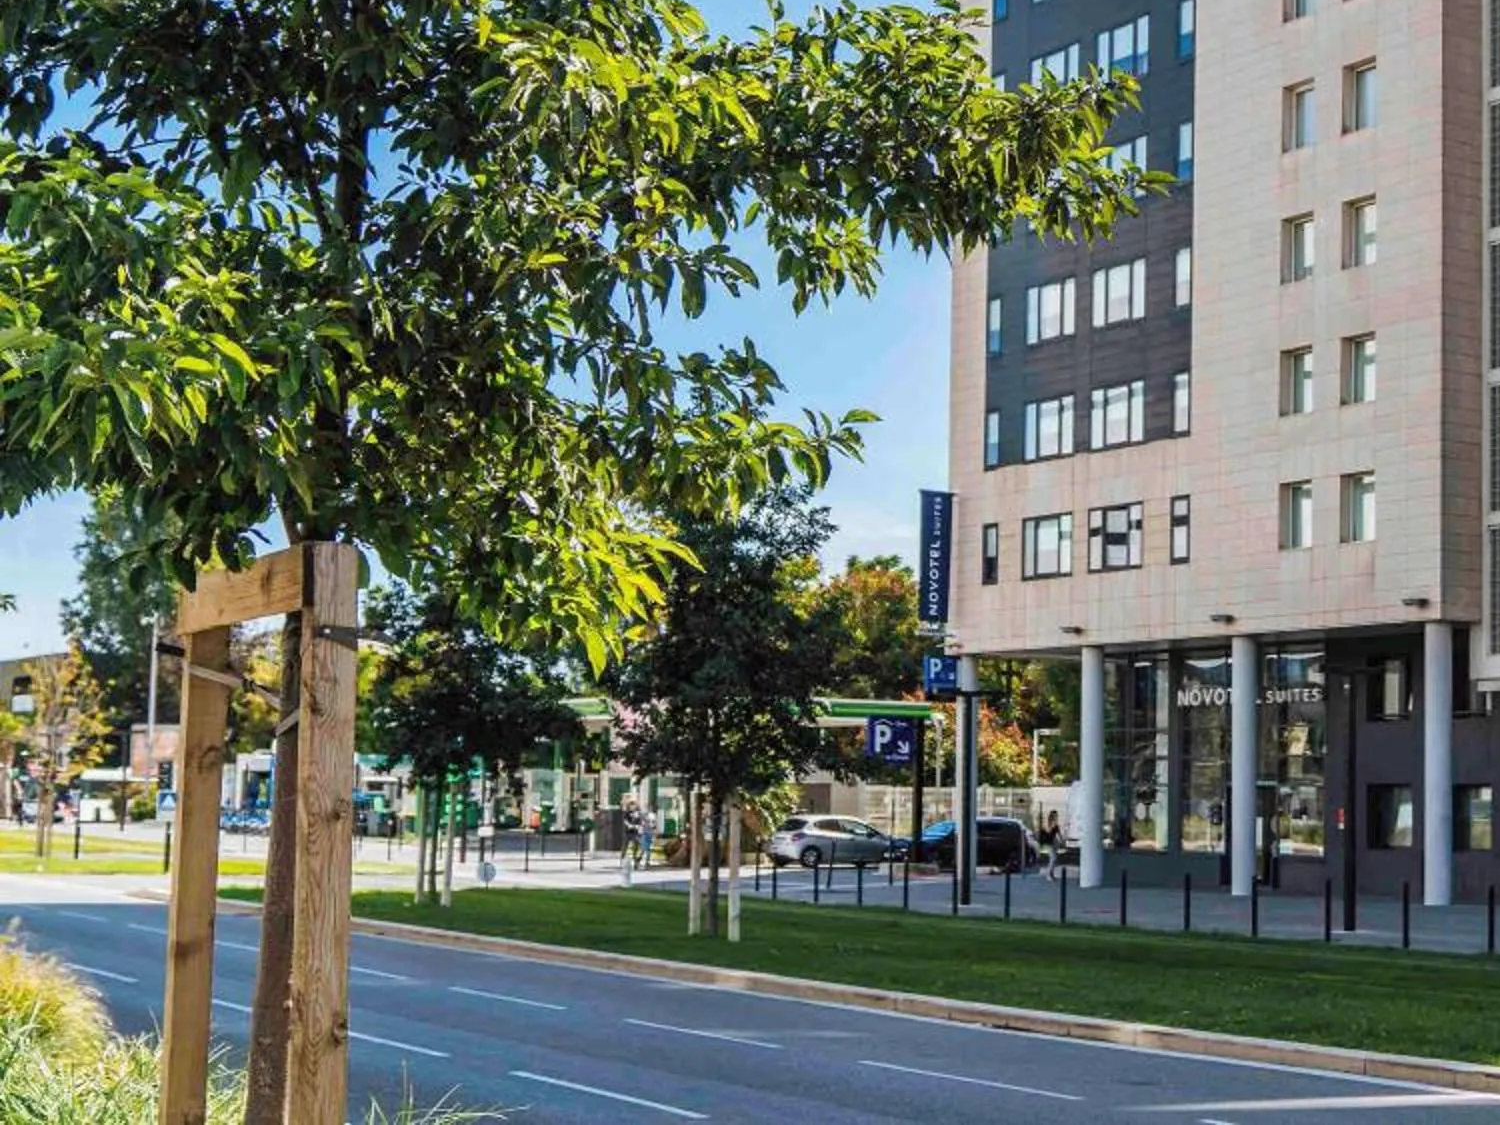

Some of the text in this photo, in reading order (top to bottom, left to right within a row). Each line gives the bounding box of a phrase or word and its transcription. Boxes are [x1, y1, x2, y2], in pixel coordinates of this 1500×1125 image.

[929, 539, 941, 616] NOVOTEL
[930, 658, 942, 679] P
[1265, 688, 1322, 704] SUITES
[875, 724, 892, 753] P
